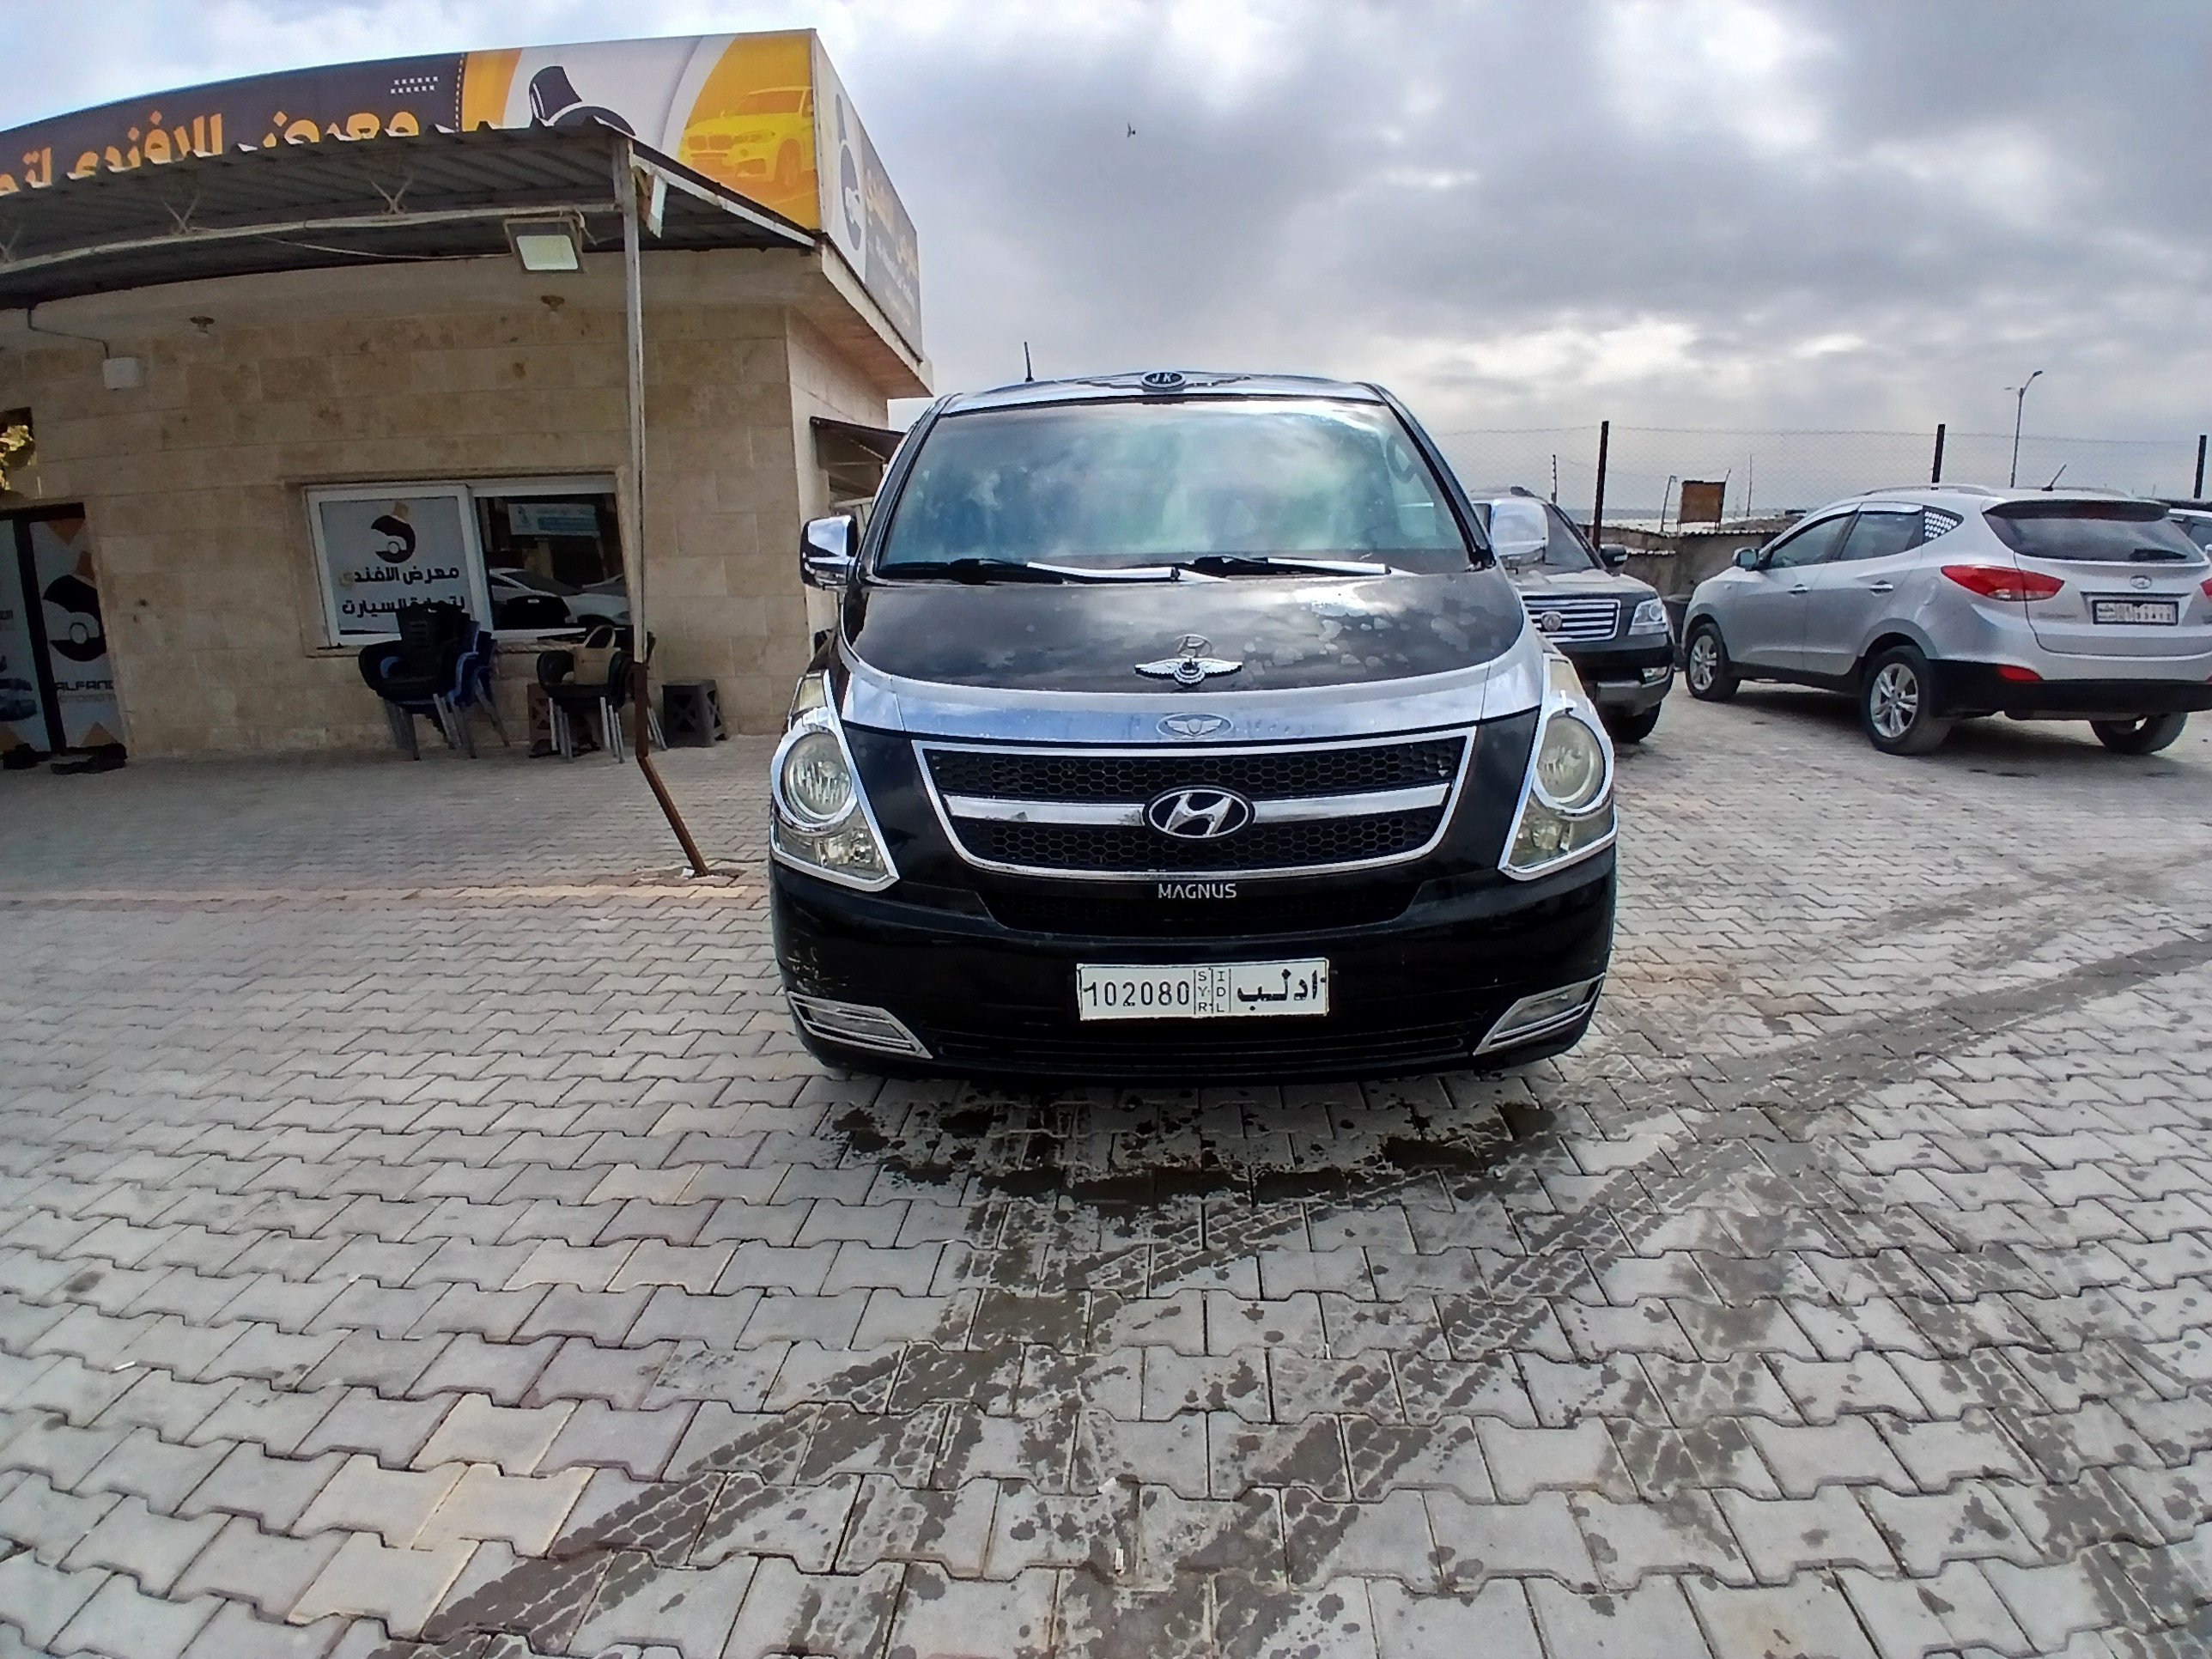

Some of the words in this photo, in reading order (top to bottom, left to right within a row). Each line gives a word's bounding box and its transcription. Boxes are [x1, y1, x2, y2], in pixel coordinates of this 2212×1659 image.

[403, 565, 459, 585] معرض
[1158, 883, 1237, 899] MAGNUS
[1083, 981, 1190, 1007] 102080
